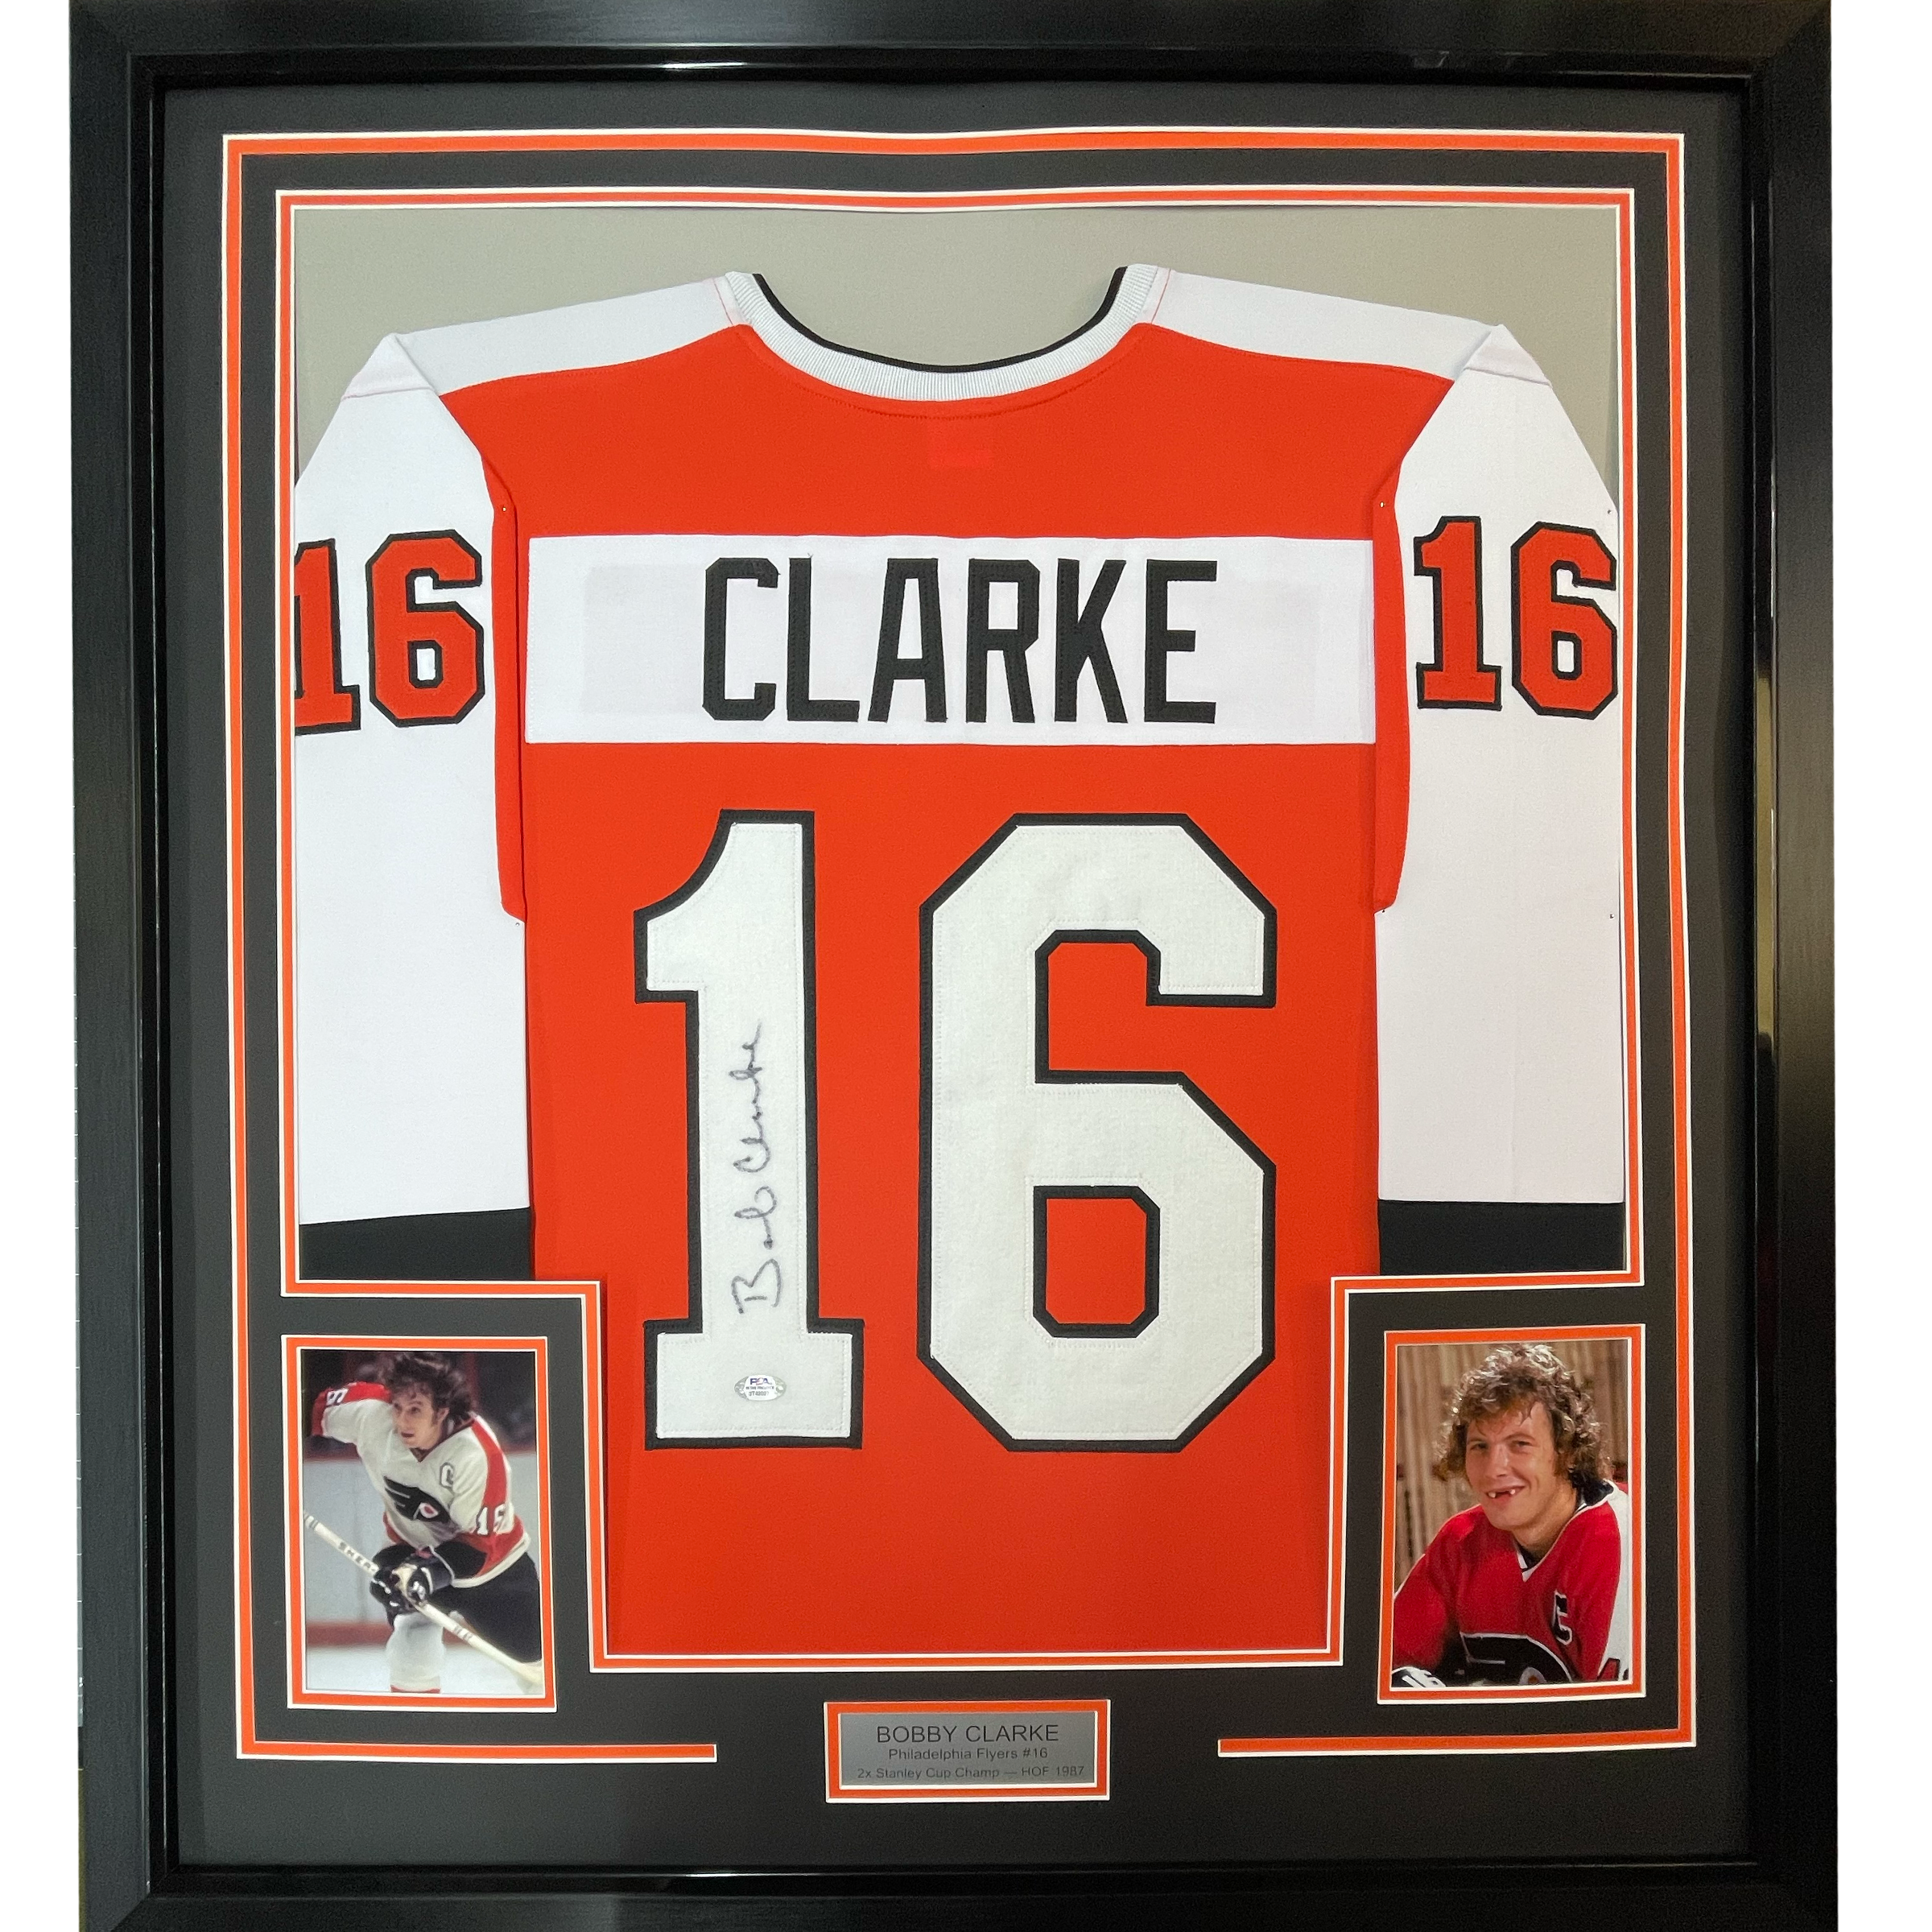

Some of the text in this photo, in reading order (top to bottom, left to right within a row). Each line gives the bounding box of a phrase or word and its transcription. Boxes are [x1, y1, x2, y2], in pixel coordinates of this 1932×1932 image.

[294, 529, 485, 736] 16
[702, 557, 1218, 724] CLARKE
[1414, 515, 1618, 720] 16
[634, 809, 1278, 1452] 16
[857, 1769, 872, 1779] 2x
[876, 1768, 923, 1781] Stanley
[926, 1767, 952, 1779] Cup
[955, 1767, 1000, 1780] Champ
[1022, 1766, 1050, 1777] HOF
[1056, 1765, 1085, 1777] 1987
[877, 1724, 1059, 1743] BOBBY CLARKE
[889, 1747, 1048, 1761] Philadelphia Flyers #16
